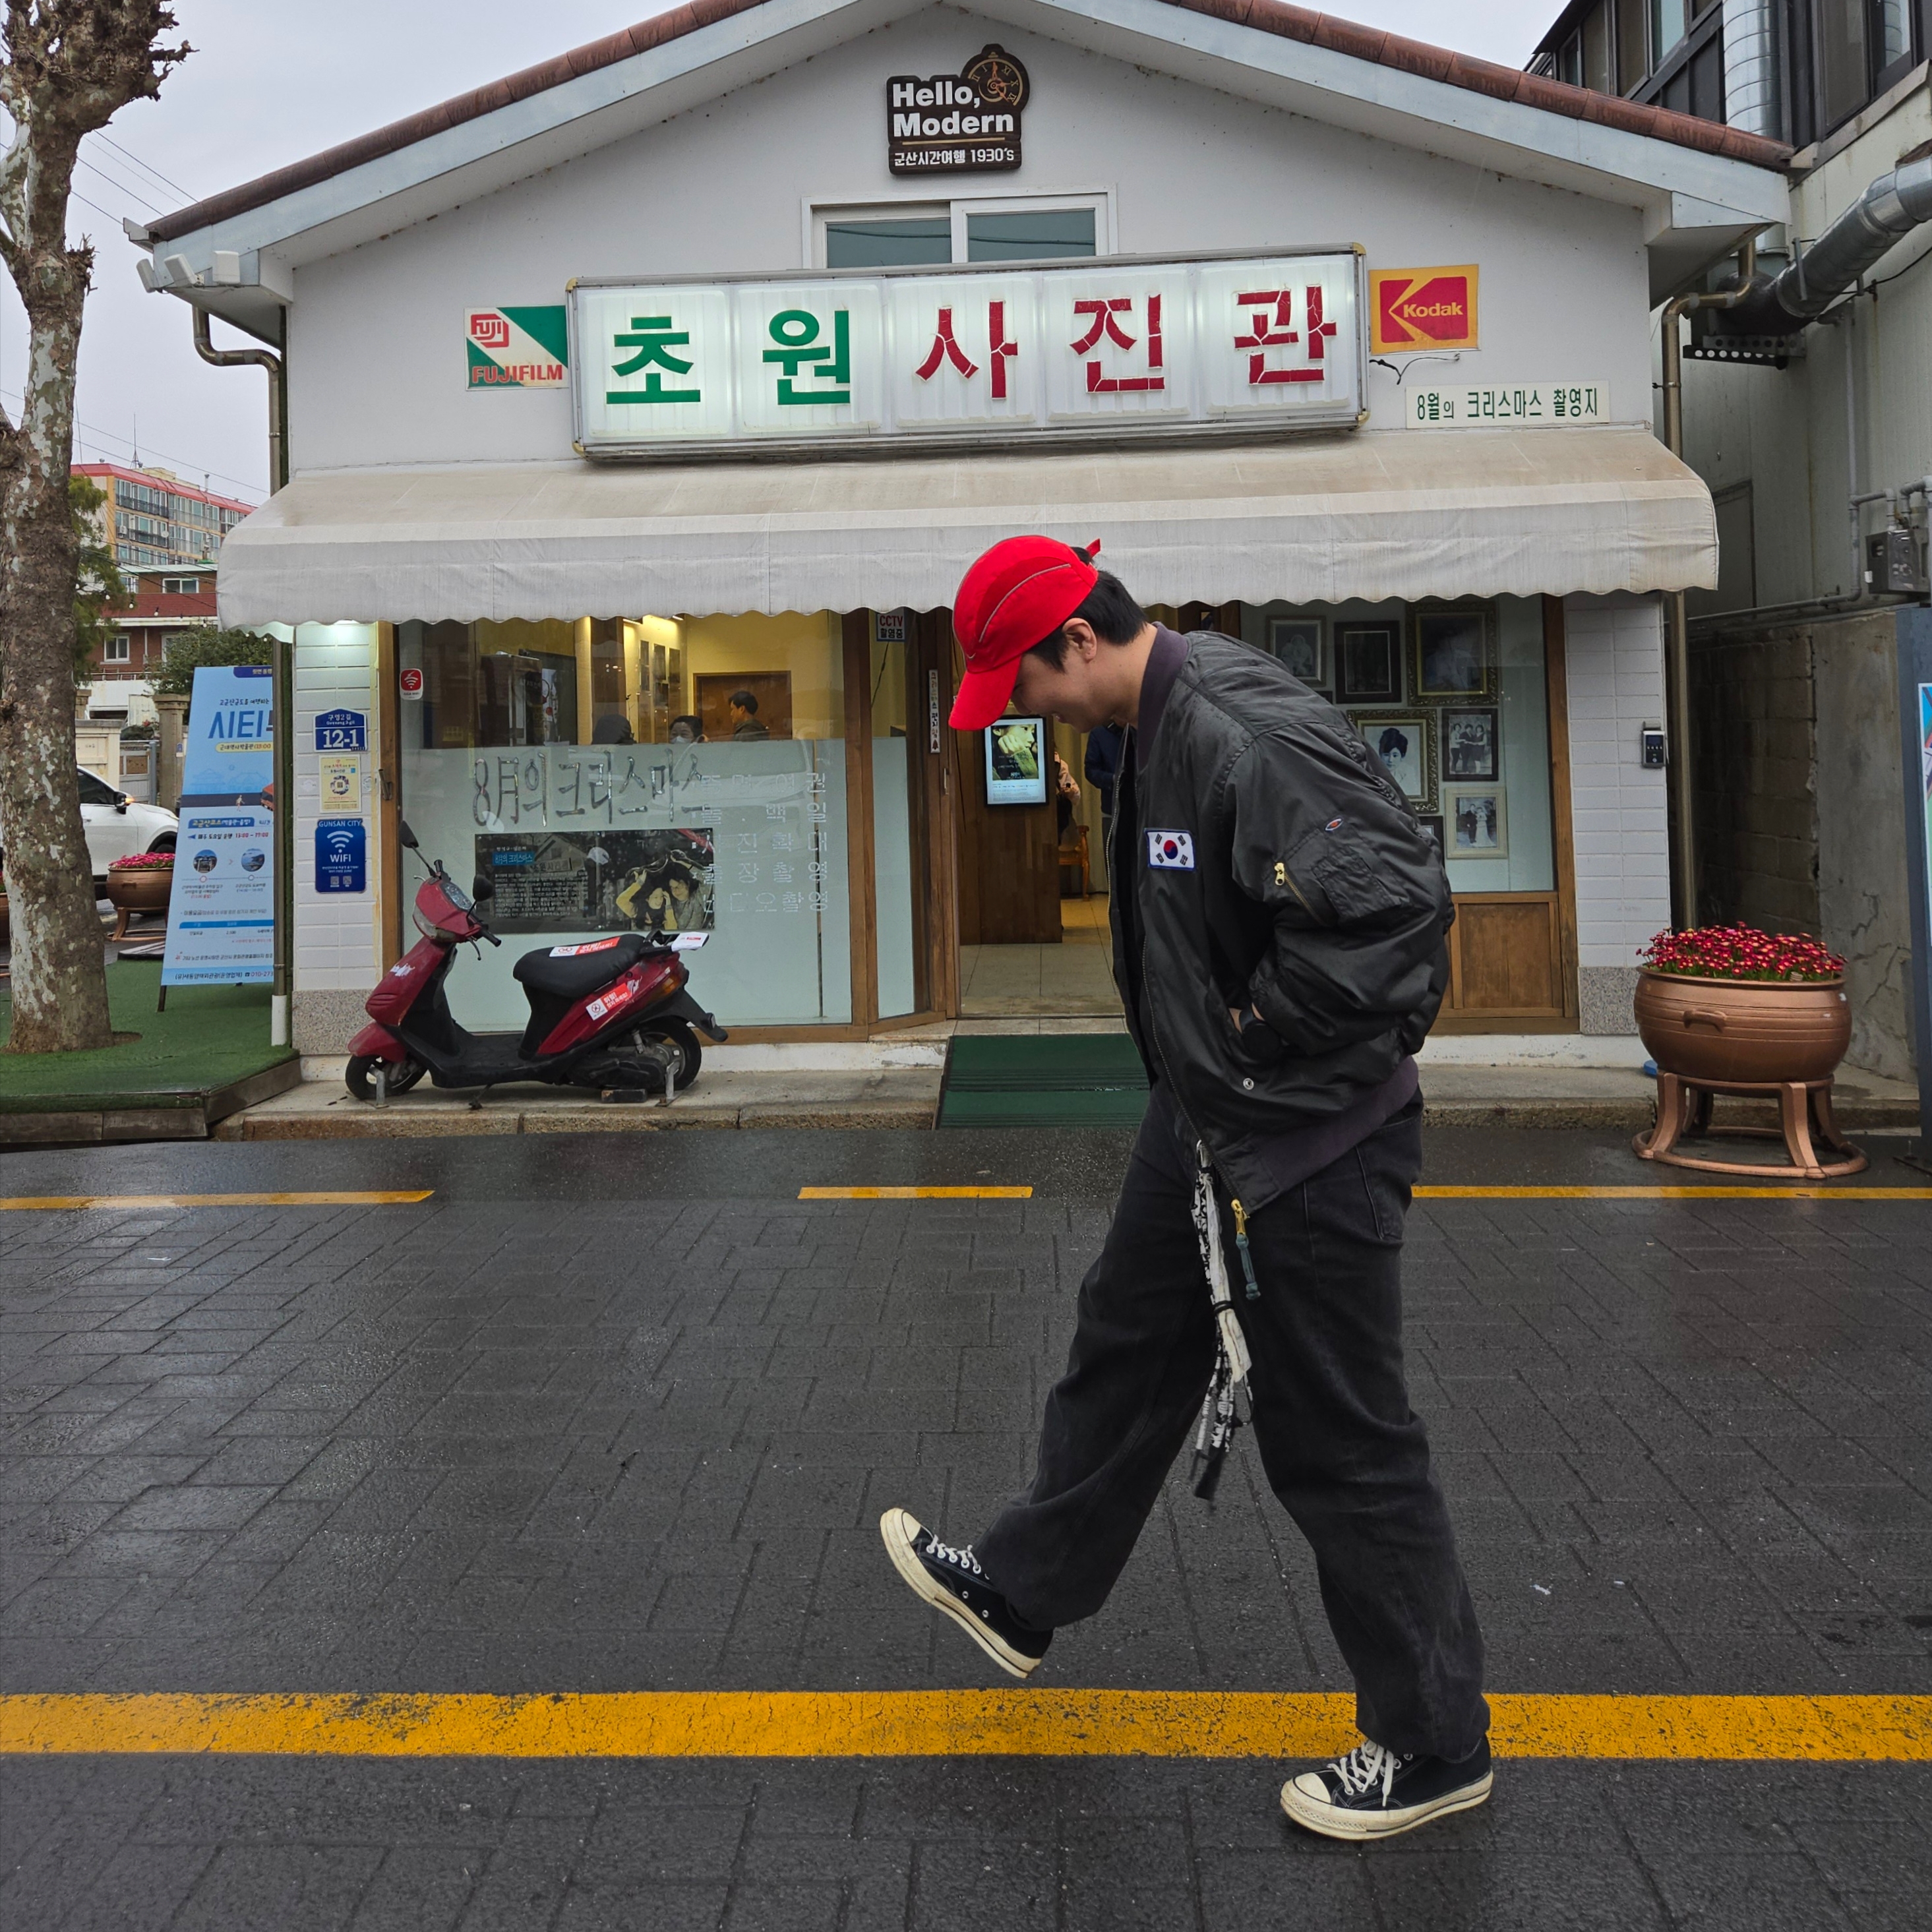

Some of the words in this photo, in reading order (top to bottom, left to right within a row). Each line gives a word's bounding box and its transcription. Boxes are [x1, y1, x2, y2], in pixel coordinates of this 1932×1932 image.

[893, 80, 981, 108] Hello,
[893, 111, 1013, 137] Modern
[895, 150, 965, 167] 군산시간여행
[971, 148, 1014, 163] 1930's
[1403, 301, 1463, 318] Kodak
[472, 364, 563, 384] FUJIFILM
[1417, 392, 1454, 421] 8월의
[1467, 390, 1542, 419] 크리스마스
[1554, 388, 1598, 418] 촬영지
[880, 615, 903, 627] CCTV
[208, 709, 273, 739] 시티
[323, 729, 359, 748] 12-1
[330, 854, 351, 862] WIFI
